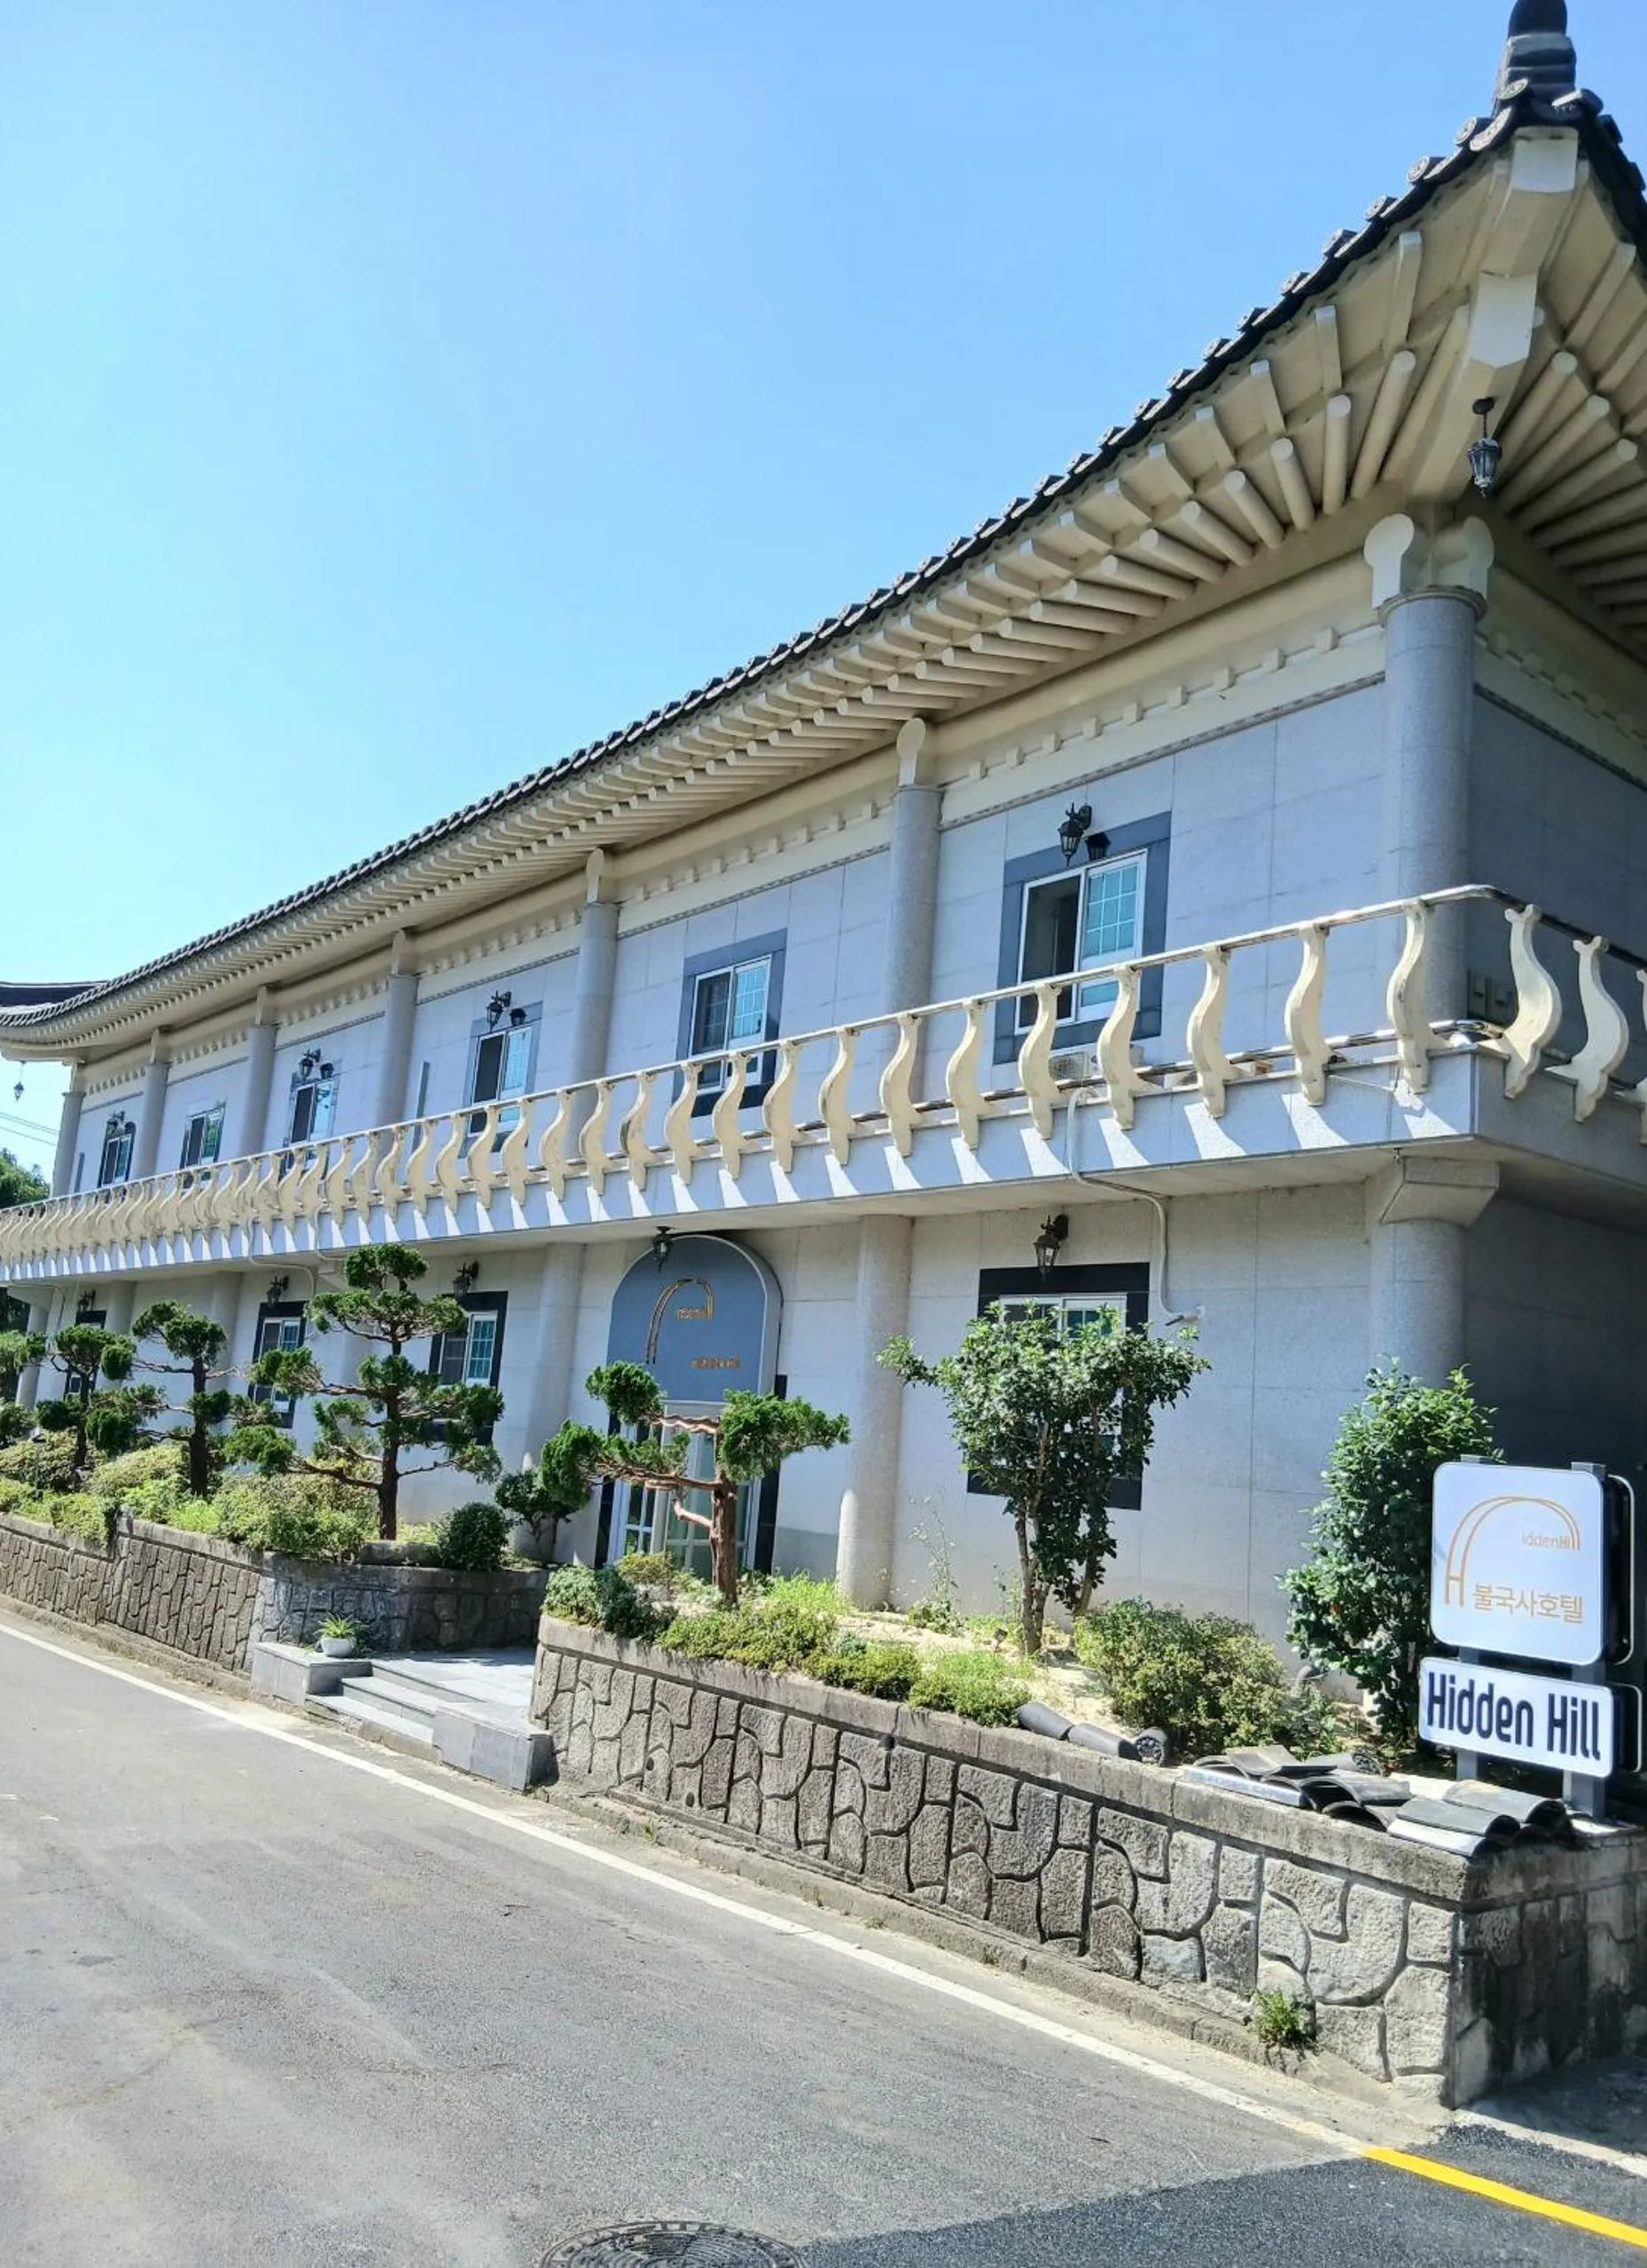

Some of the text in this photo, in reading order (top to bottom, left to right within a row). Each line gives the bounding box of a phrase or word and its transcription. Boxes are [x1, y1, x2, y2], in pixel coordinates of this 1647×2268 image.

[1472, 1583, 1584, 1624] 불국사호텔
[1427, 1671, 1601, 1760] Hidden Hill
